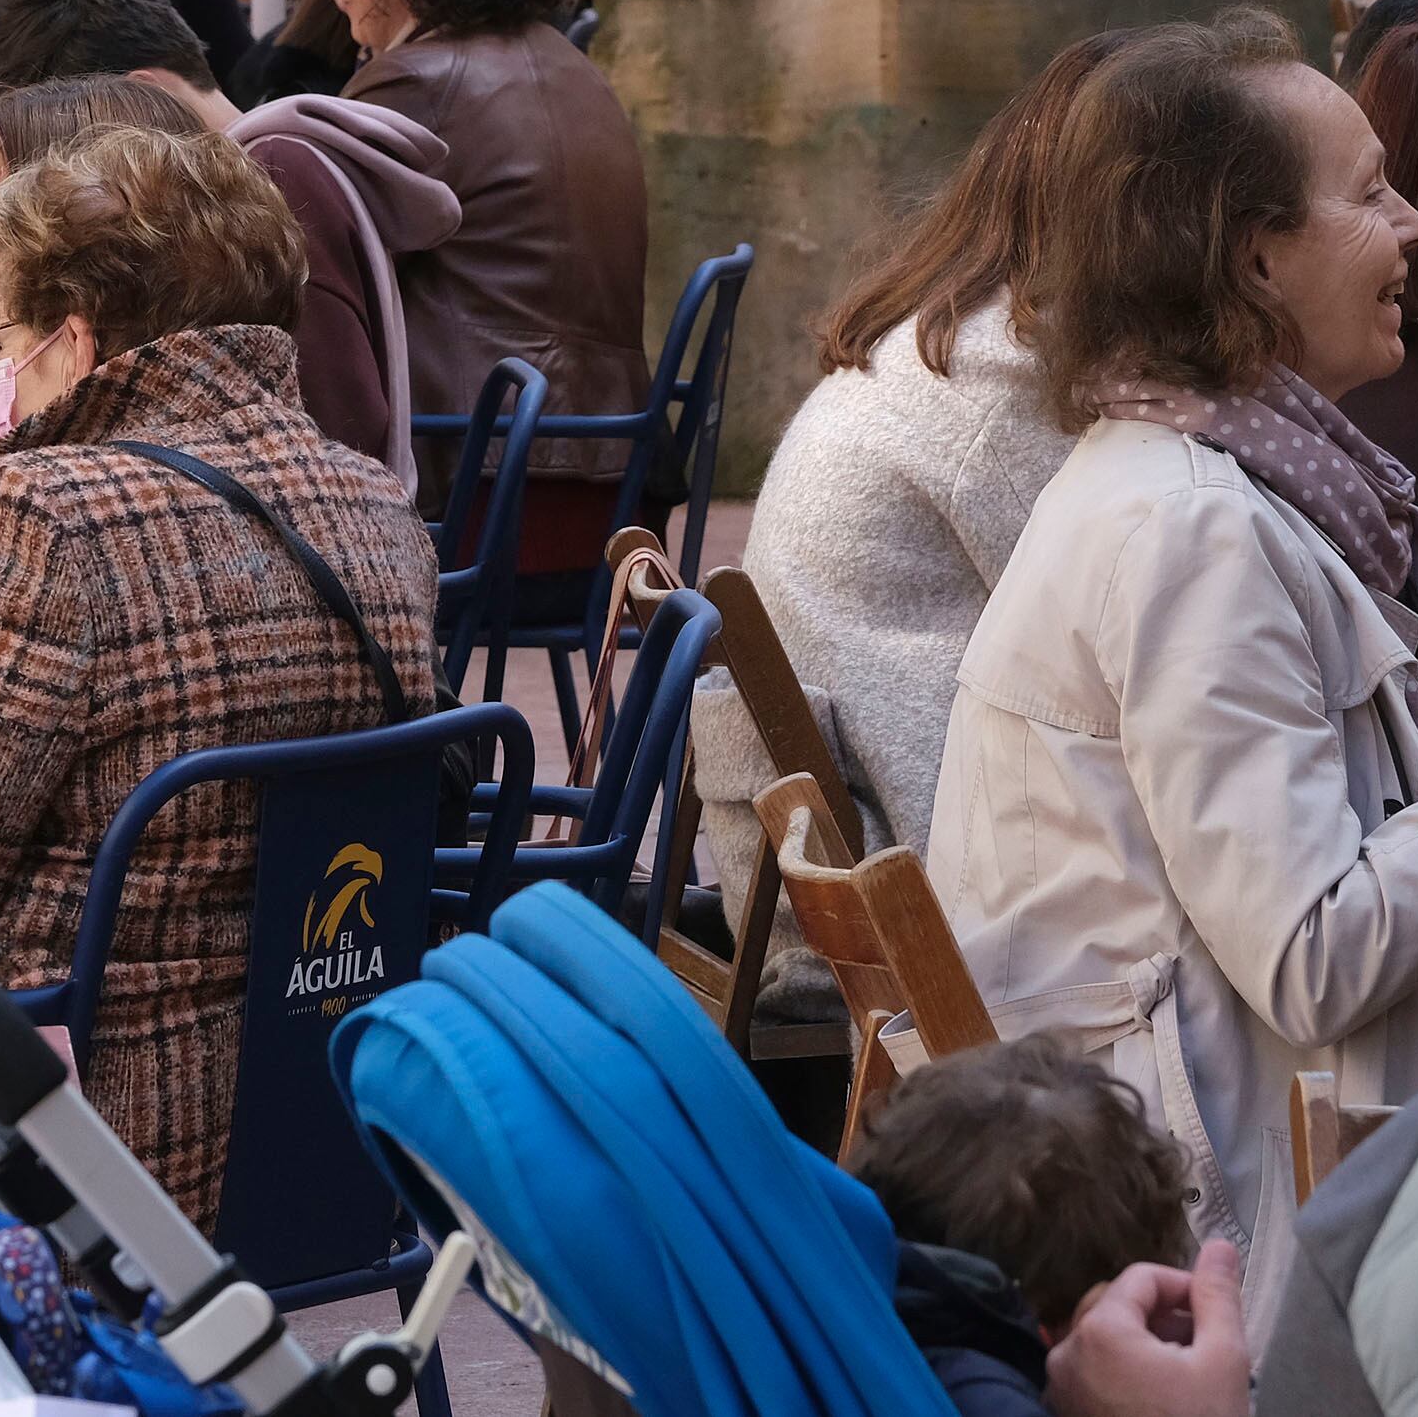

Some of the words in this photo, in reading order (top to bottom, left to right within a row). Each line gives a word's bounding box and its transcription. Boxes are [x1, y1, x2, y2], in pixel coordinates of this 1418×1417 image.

[339, 930, 355, 951] EL
[285, 946, 385, 998] ÁGUILA
[321, 996, 346, 1018] 1900
